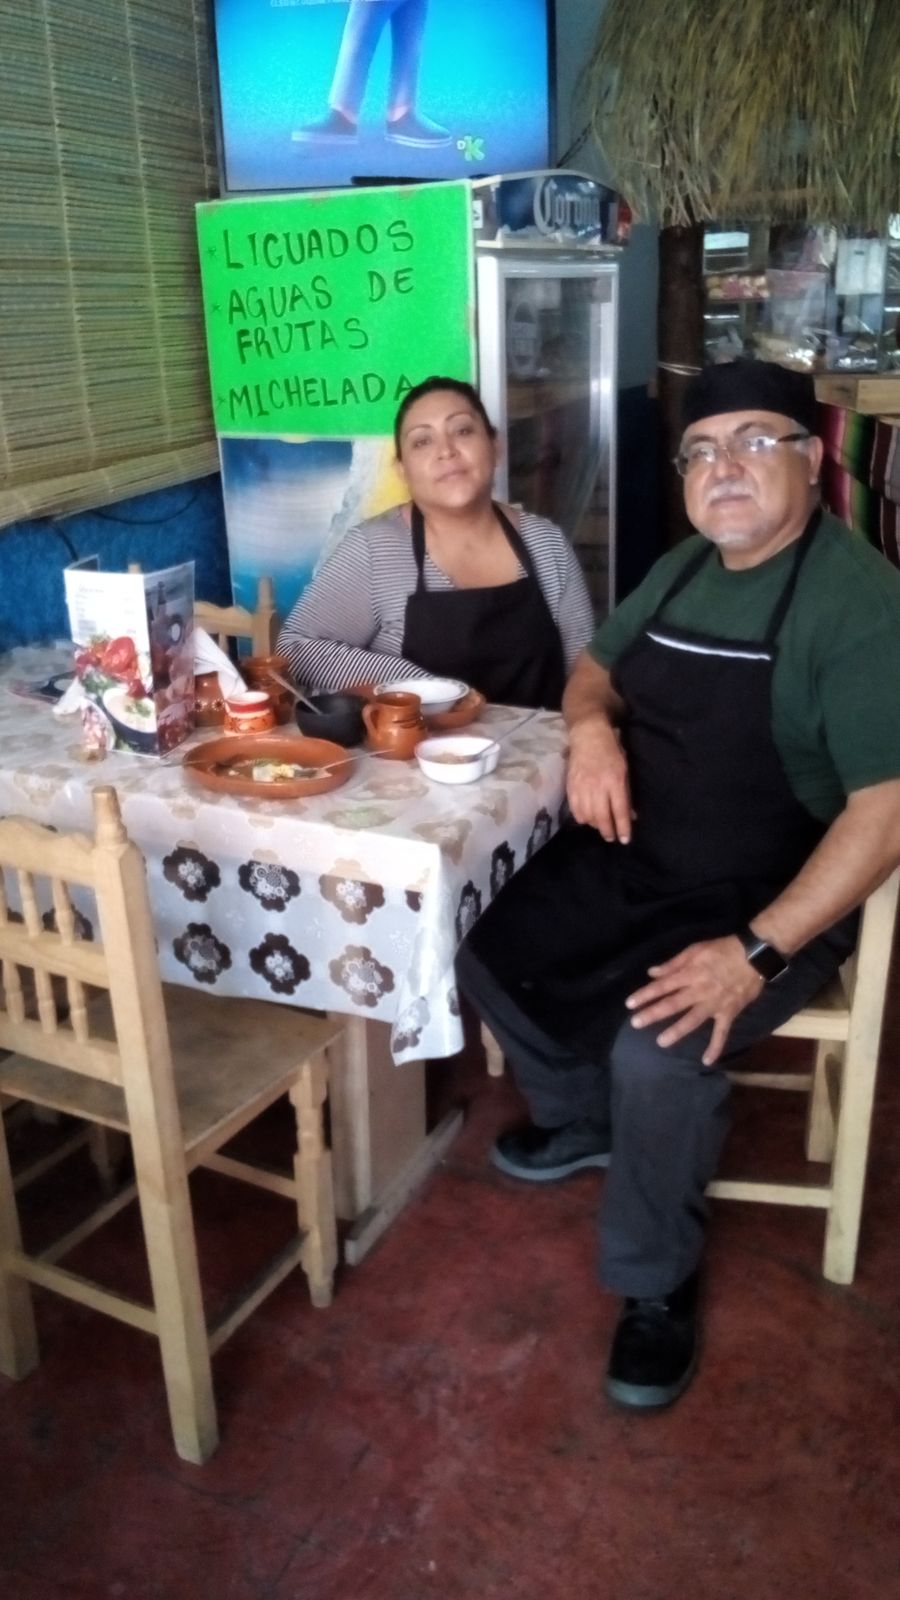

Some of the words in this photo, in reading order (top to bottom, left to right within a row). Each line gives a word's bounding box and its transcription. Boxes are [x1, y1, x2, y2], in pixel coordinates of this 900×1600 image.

[228, 275, 333, 327] AGUAS
[367, 267, 414, 303] DE
[236, 318, 369, 365] FRUTAS
